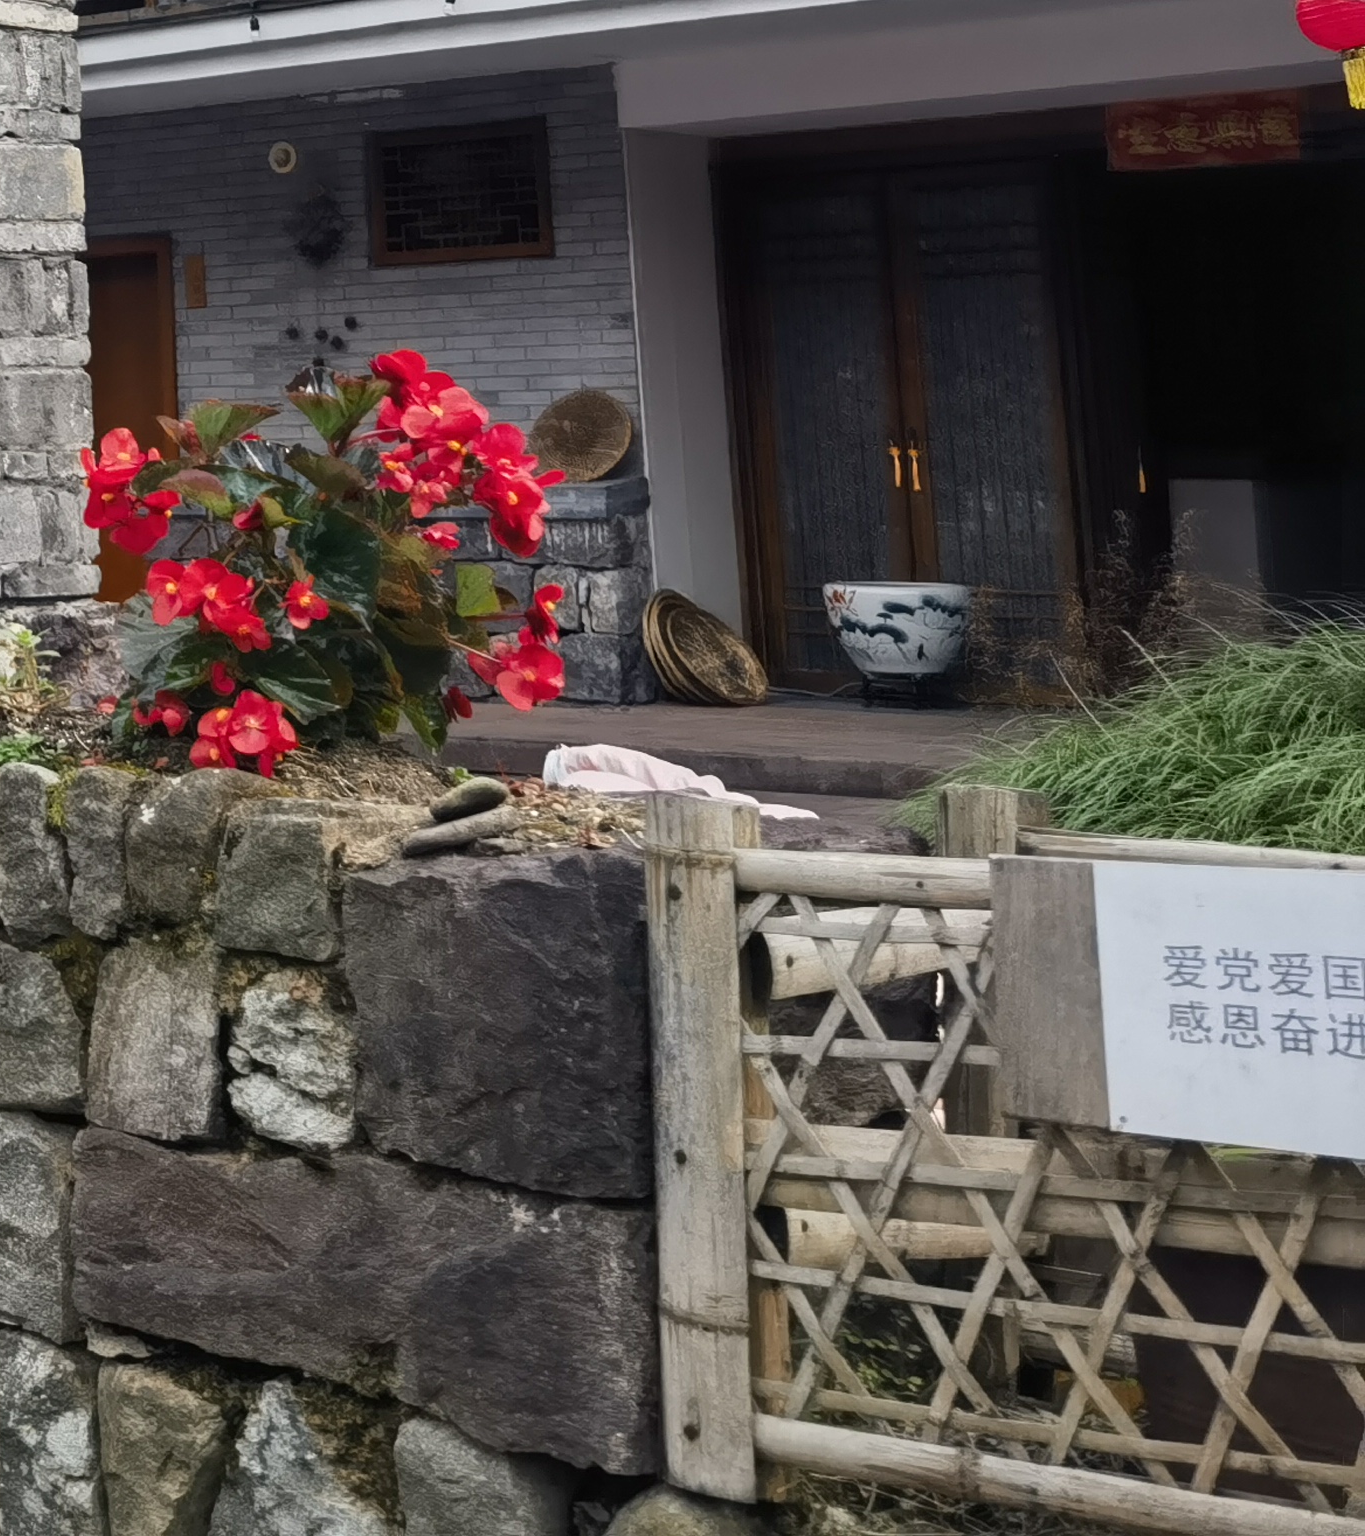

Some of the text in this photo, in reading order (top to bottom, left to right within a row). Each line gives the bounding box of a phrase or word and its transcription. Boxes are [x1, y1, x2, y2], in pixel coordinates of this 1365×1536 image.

[1162, 944, 1365, 1001] 爱党爱国
[1167, 1000, 1365, 1061] 感恩奋进
